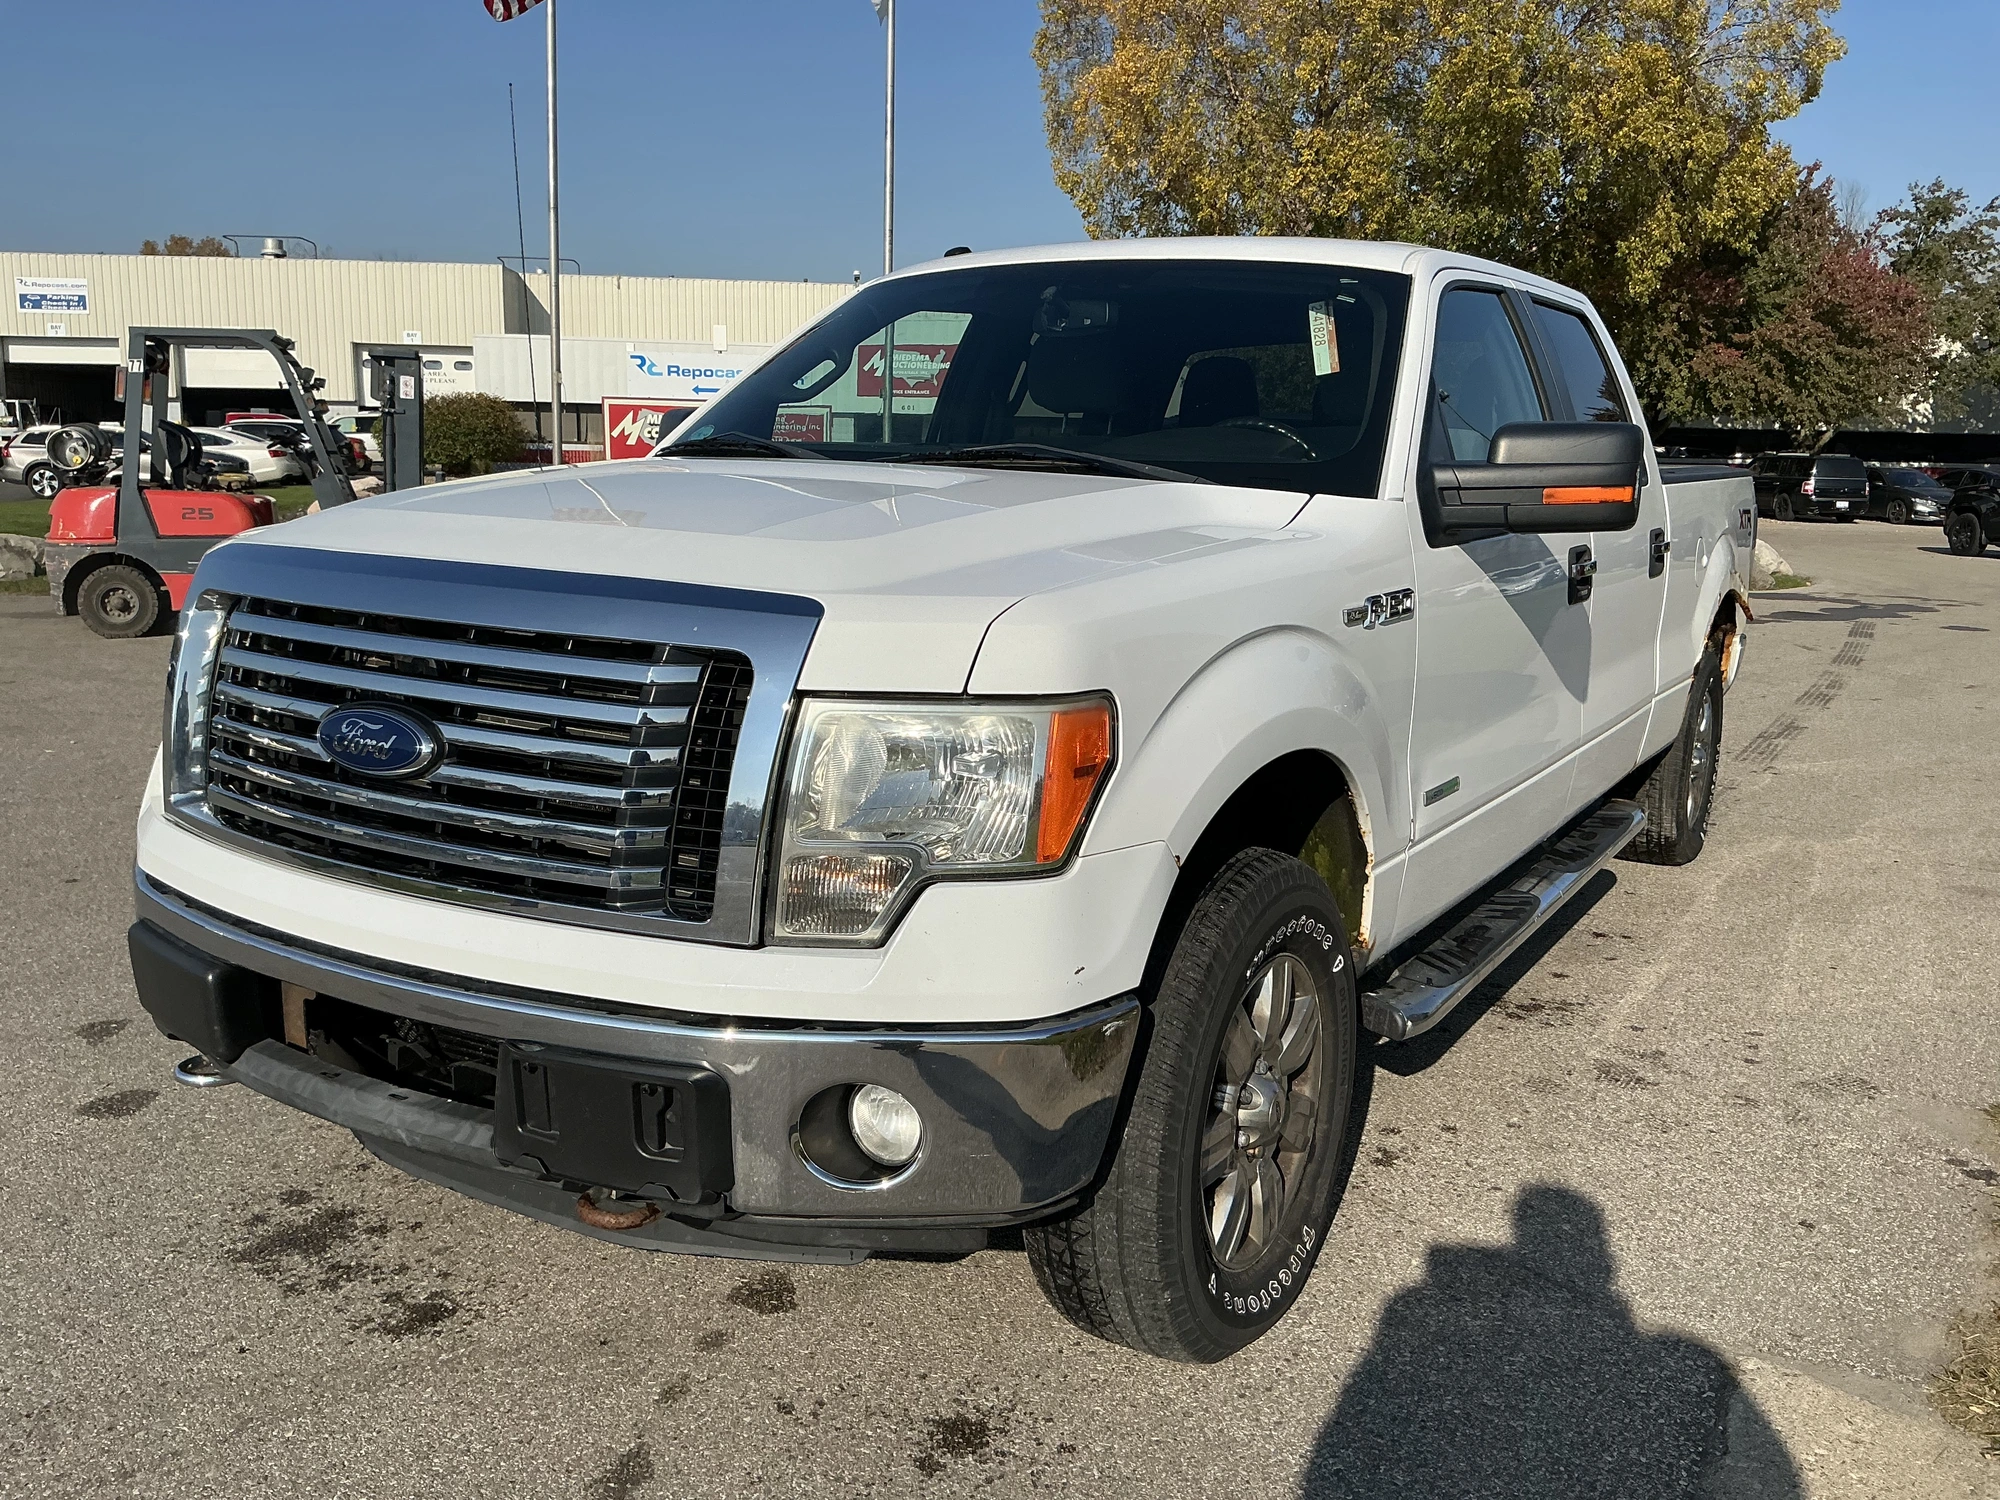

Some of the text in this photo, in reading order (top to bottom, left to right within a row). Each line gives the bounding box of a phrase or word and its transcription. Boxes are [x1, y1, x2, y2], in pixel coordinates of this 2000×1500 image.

[129, 359, 142, 372] 77
[182, 507, 214, 520] 25
[332, 717, 398, 760] Ford
[1224, 1224, 1316, 1314] Firestone
